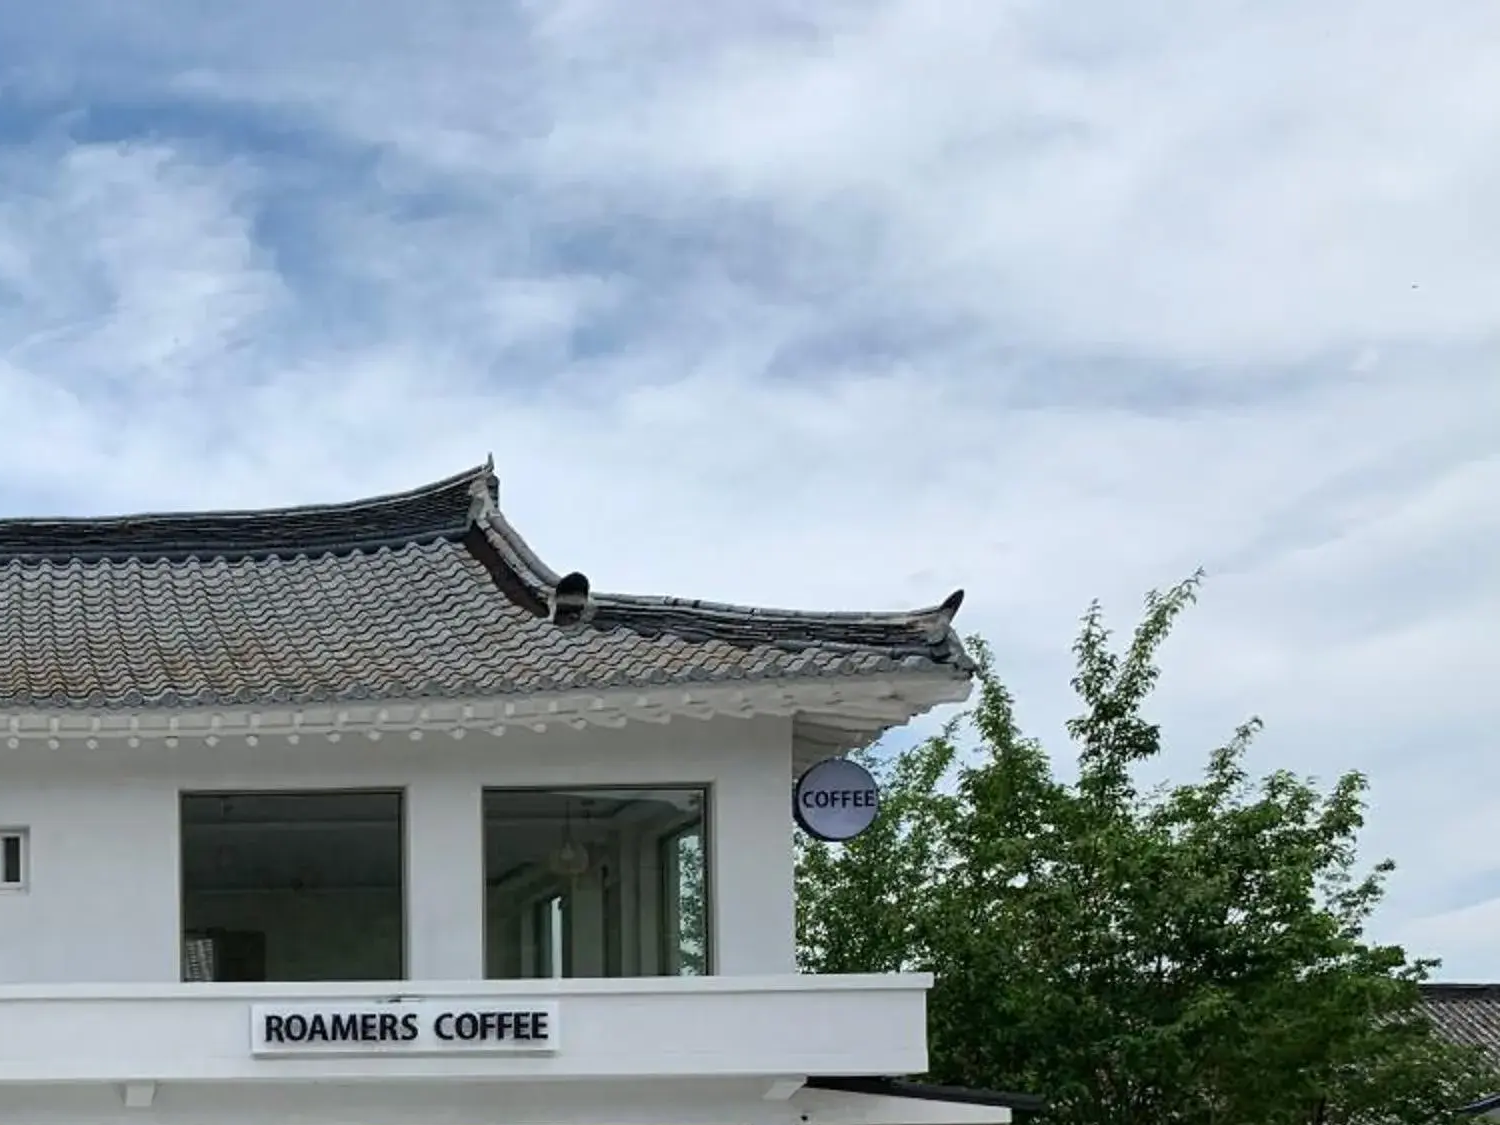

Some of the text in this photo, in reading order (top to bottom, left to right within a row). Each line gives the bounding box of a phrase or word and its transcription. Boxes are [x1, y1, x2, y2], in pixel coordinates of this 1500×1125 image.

[803, 790, 876, 808] COFFEE
[264, 1011, 549, 1043] ROAMERS COFFEE
